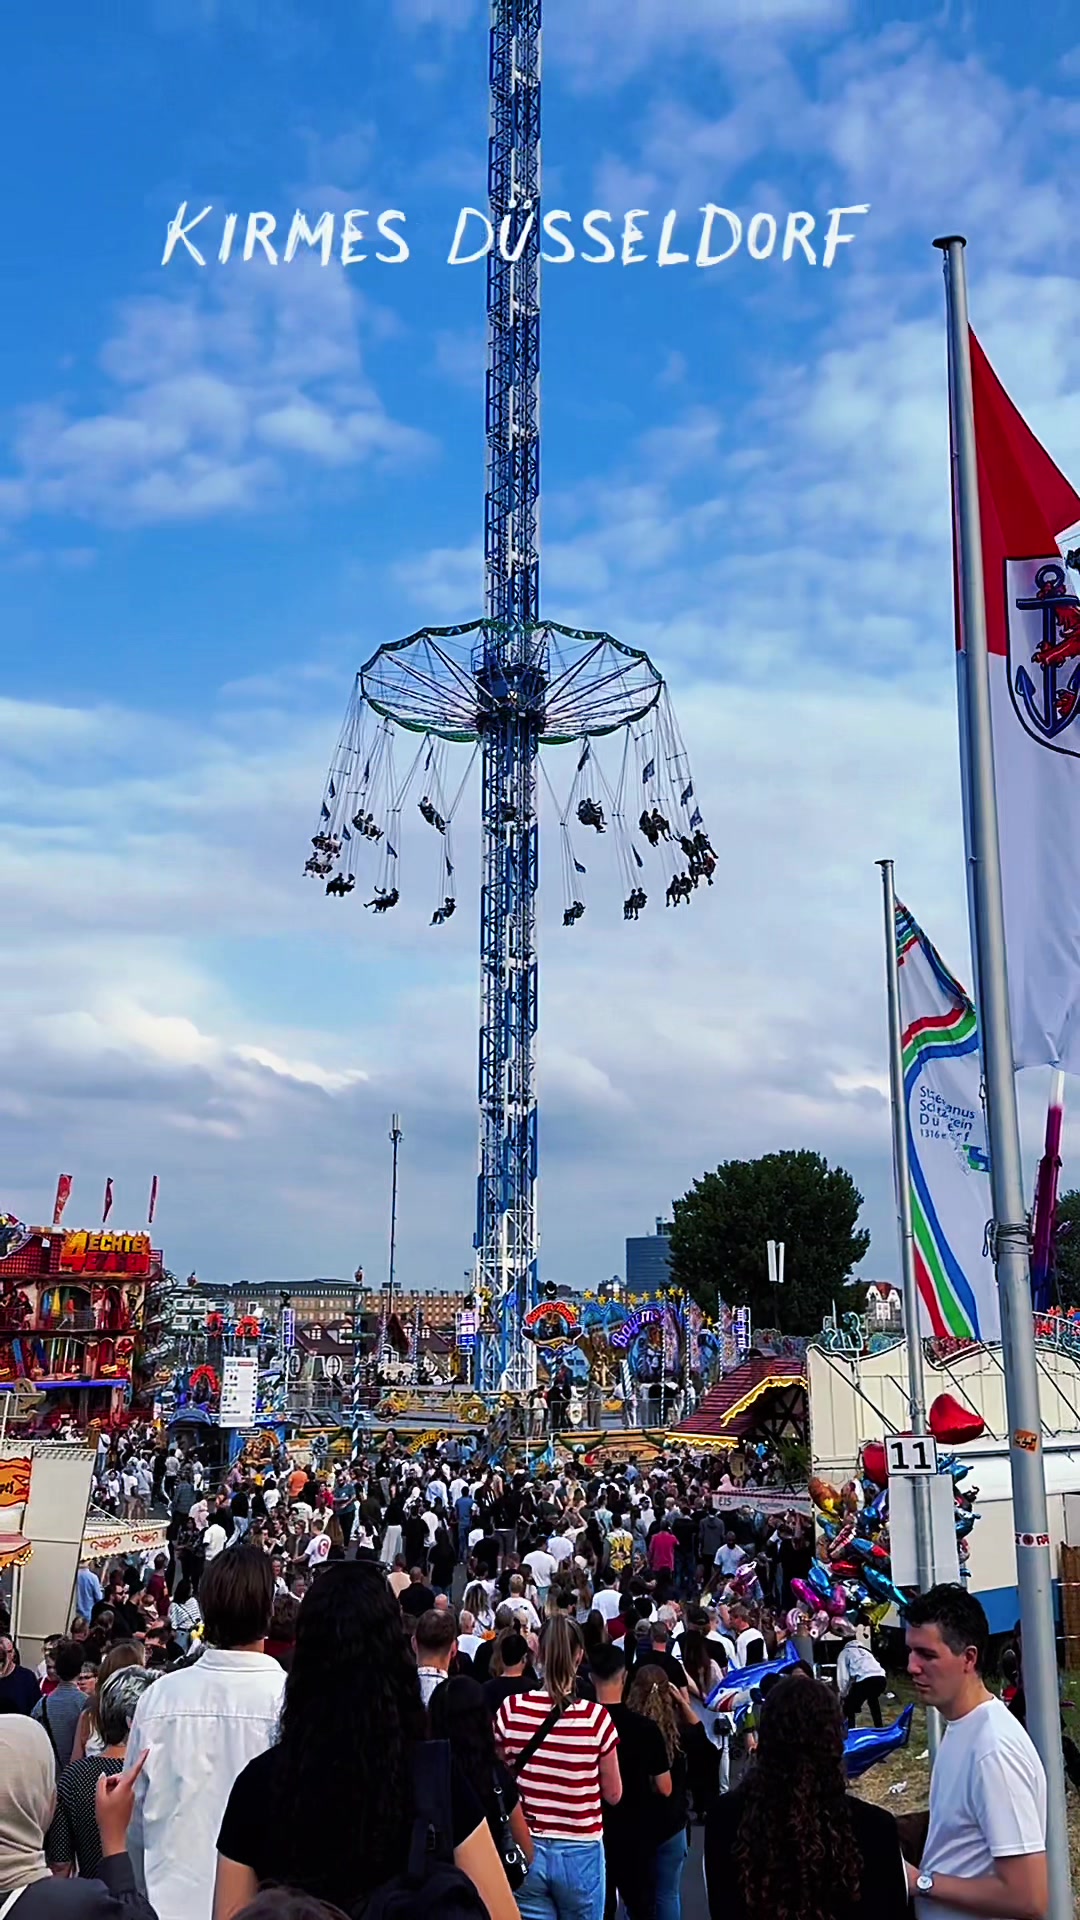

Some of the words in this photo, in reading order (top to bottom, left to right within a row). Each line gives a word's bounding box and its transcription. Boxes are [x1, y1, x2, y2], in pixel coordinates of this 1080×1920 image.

[88, 1234, 144, 1253] ECHTE
[611, 1310, 654, 1347] Bayern
[890, 1441, 932, 1469] 11
